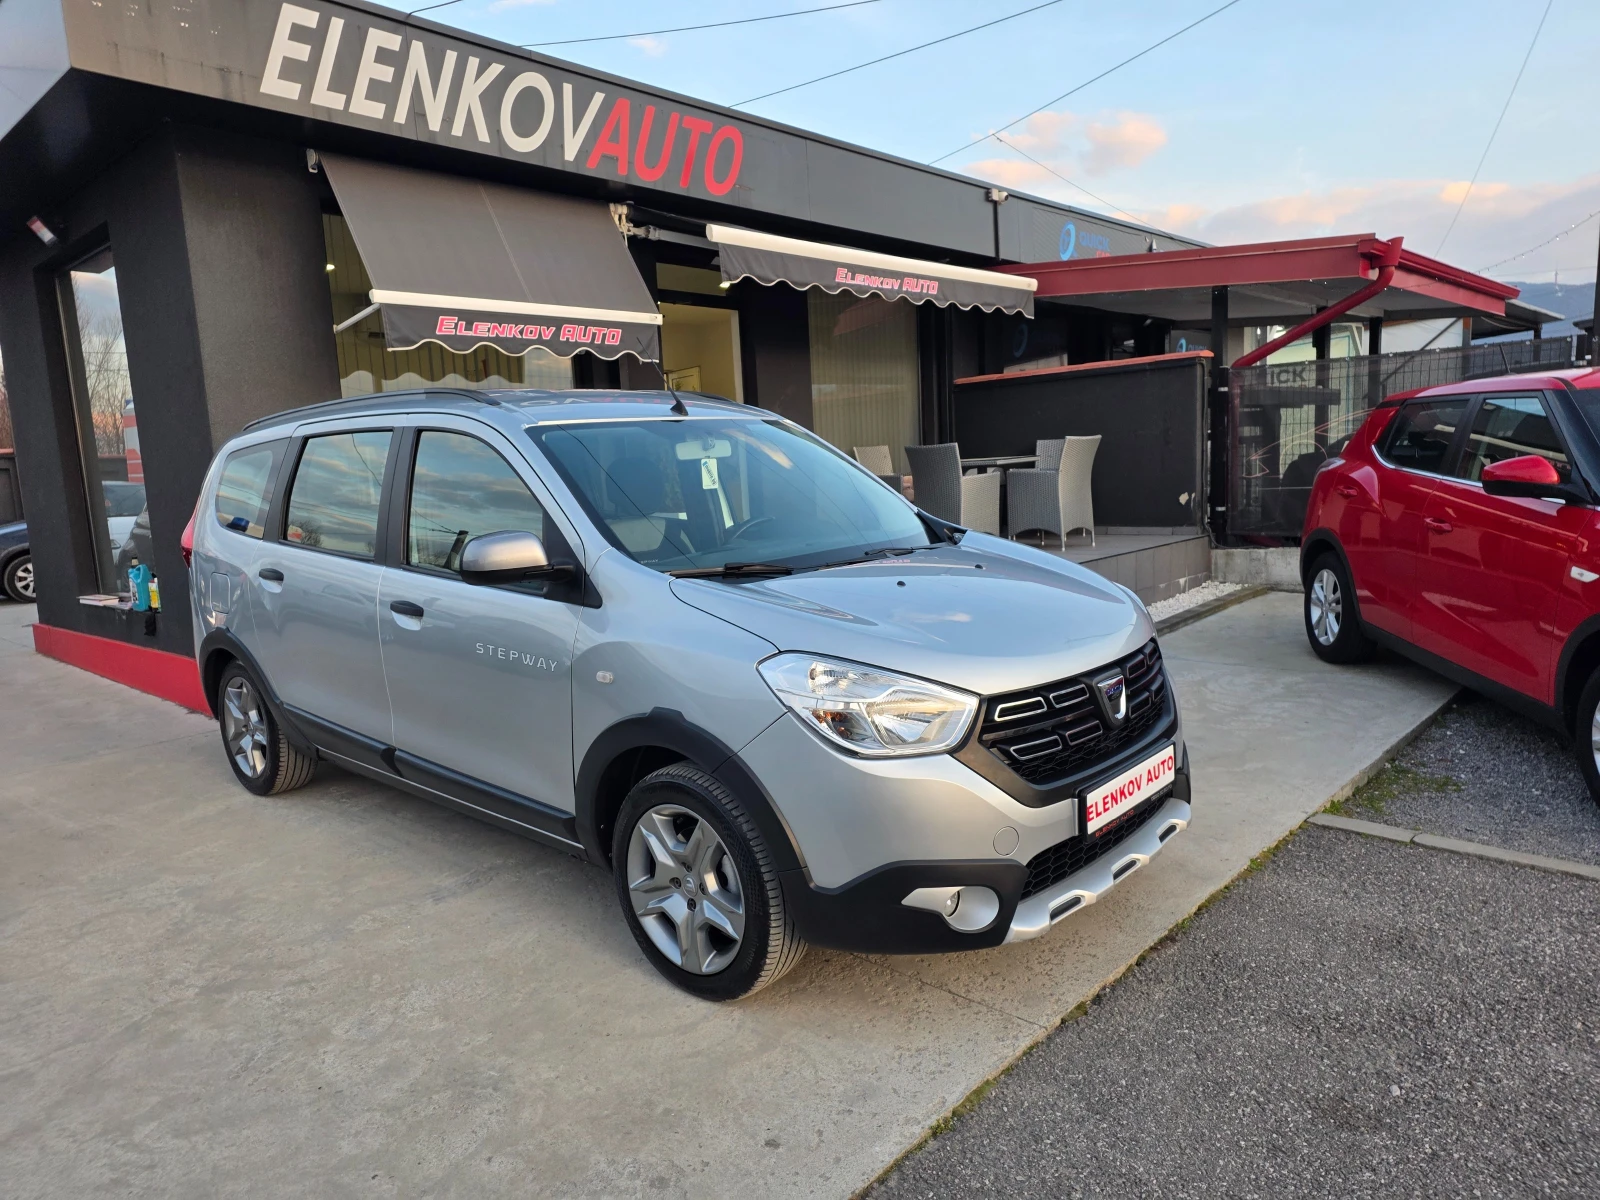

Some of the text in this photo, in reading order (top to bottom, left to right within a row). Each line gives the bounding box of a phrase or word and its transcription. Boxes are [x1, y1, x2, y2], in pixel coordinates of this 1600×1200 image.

[260, 2, 744, 195] ELENKOV AUTO
[835, 267, 939, 295] ELENKOV AUTO
[435, 315, 622, 345] ELENKOV AUTO
[475, 642, 558, 672] STEPWAY
[1086, 773, 1143, 823] ELENKOV
[1146, 755, 1174, 786] AUTO
